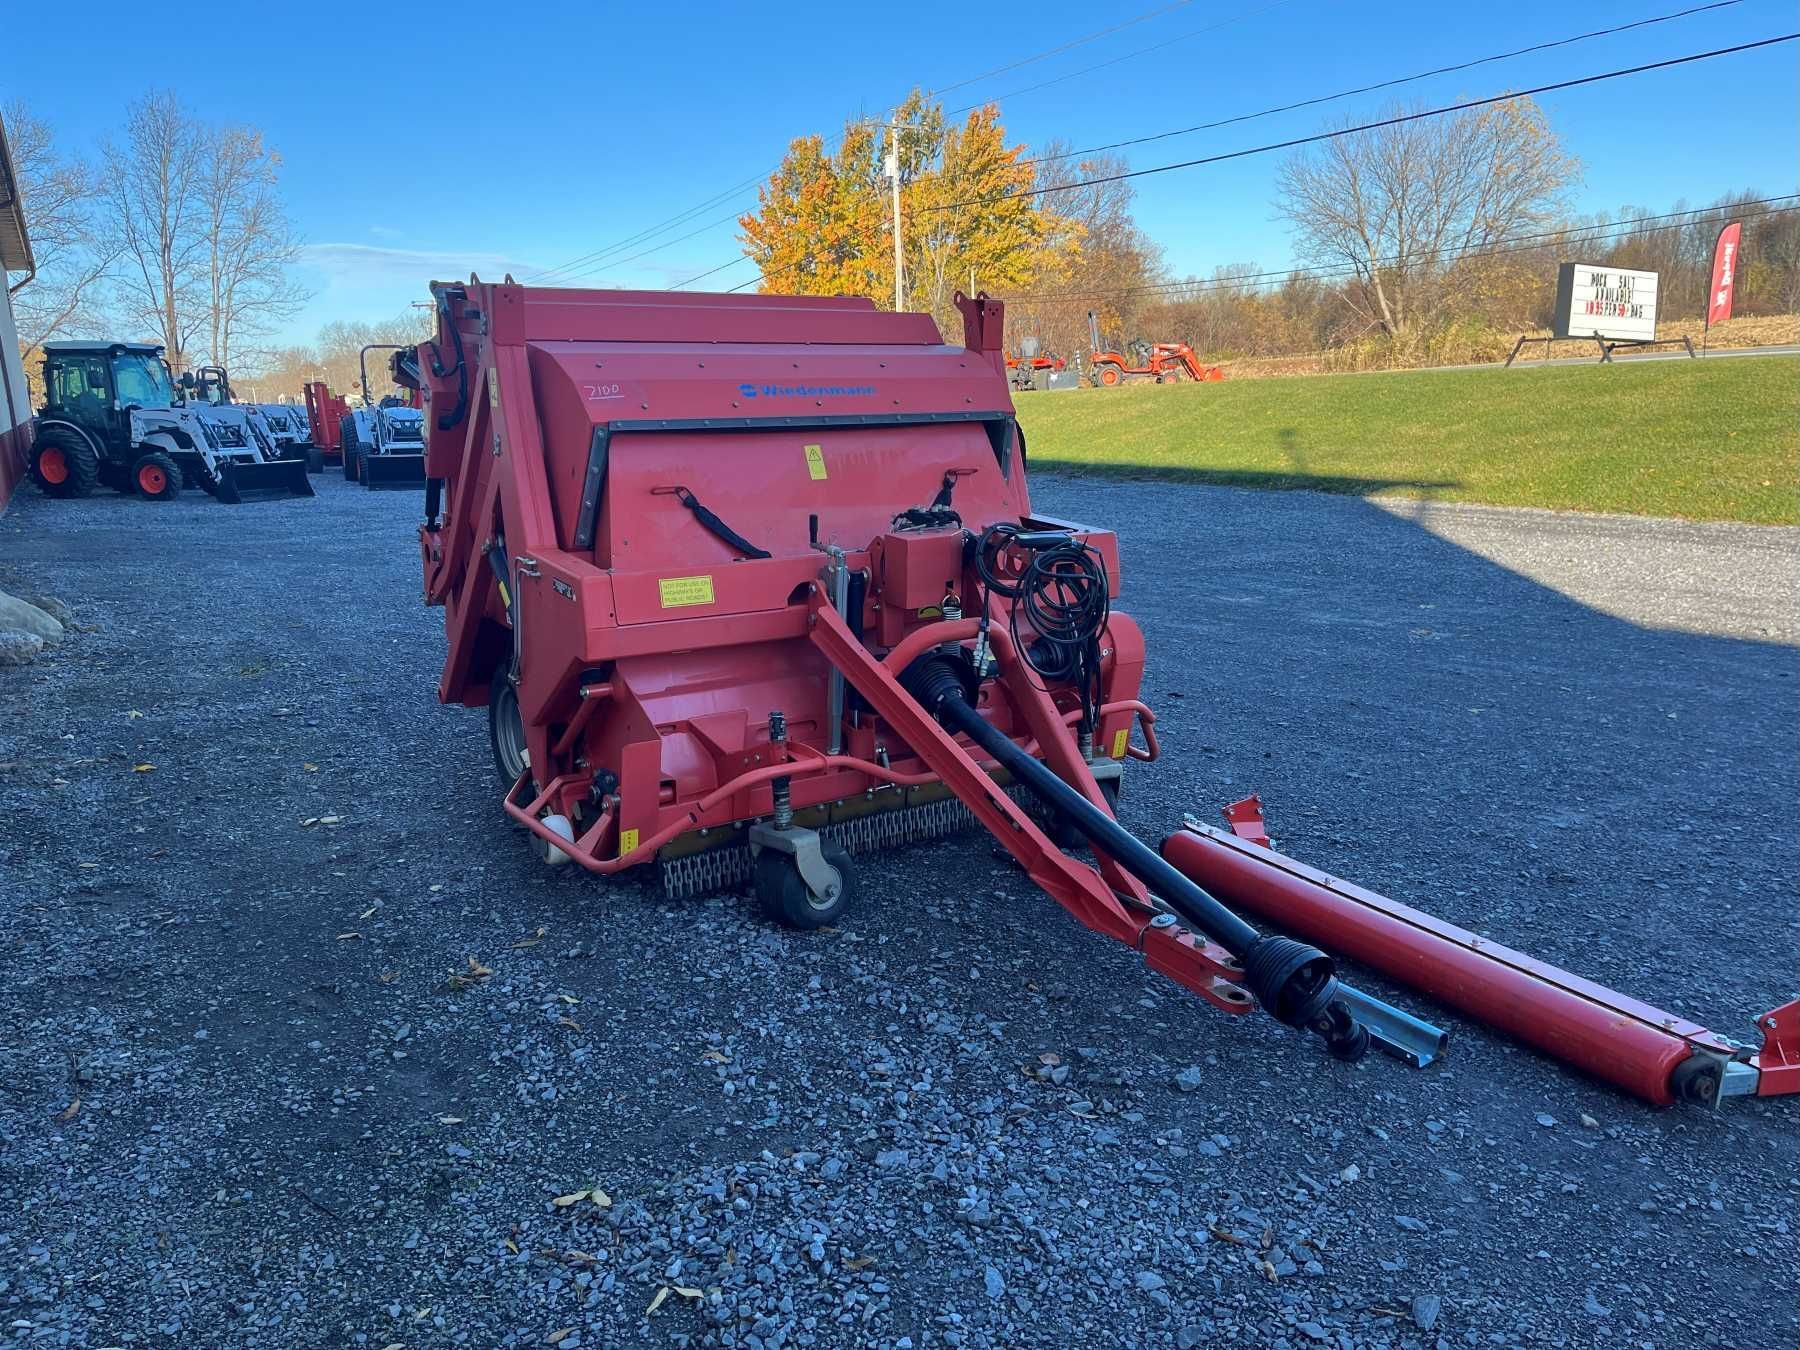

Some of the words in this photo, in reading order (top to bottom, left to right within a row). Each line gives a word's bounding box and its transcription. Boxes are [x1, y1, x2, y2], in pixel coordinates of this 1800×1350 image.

[1591, 273, 1607, 288] ROCK
[1619, 275, 1635, 290] SALT
[1631, 305, 1643, 319] BAG
